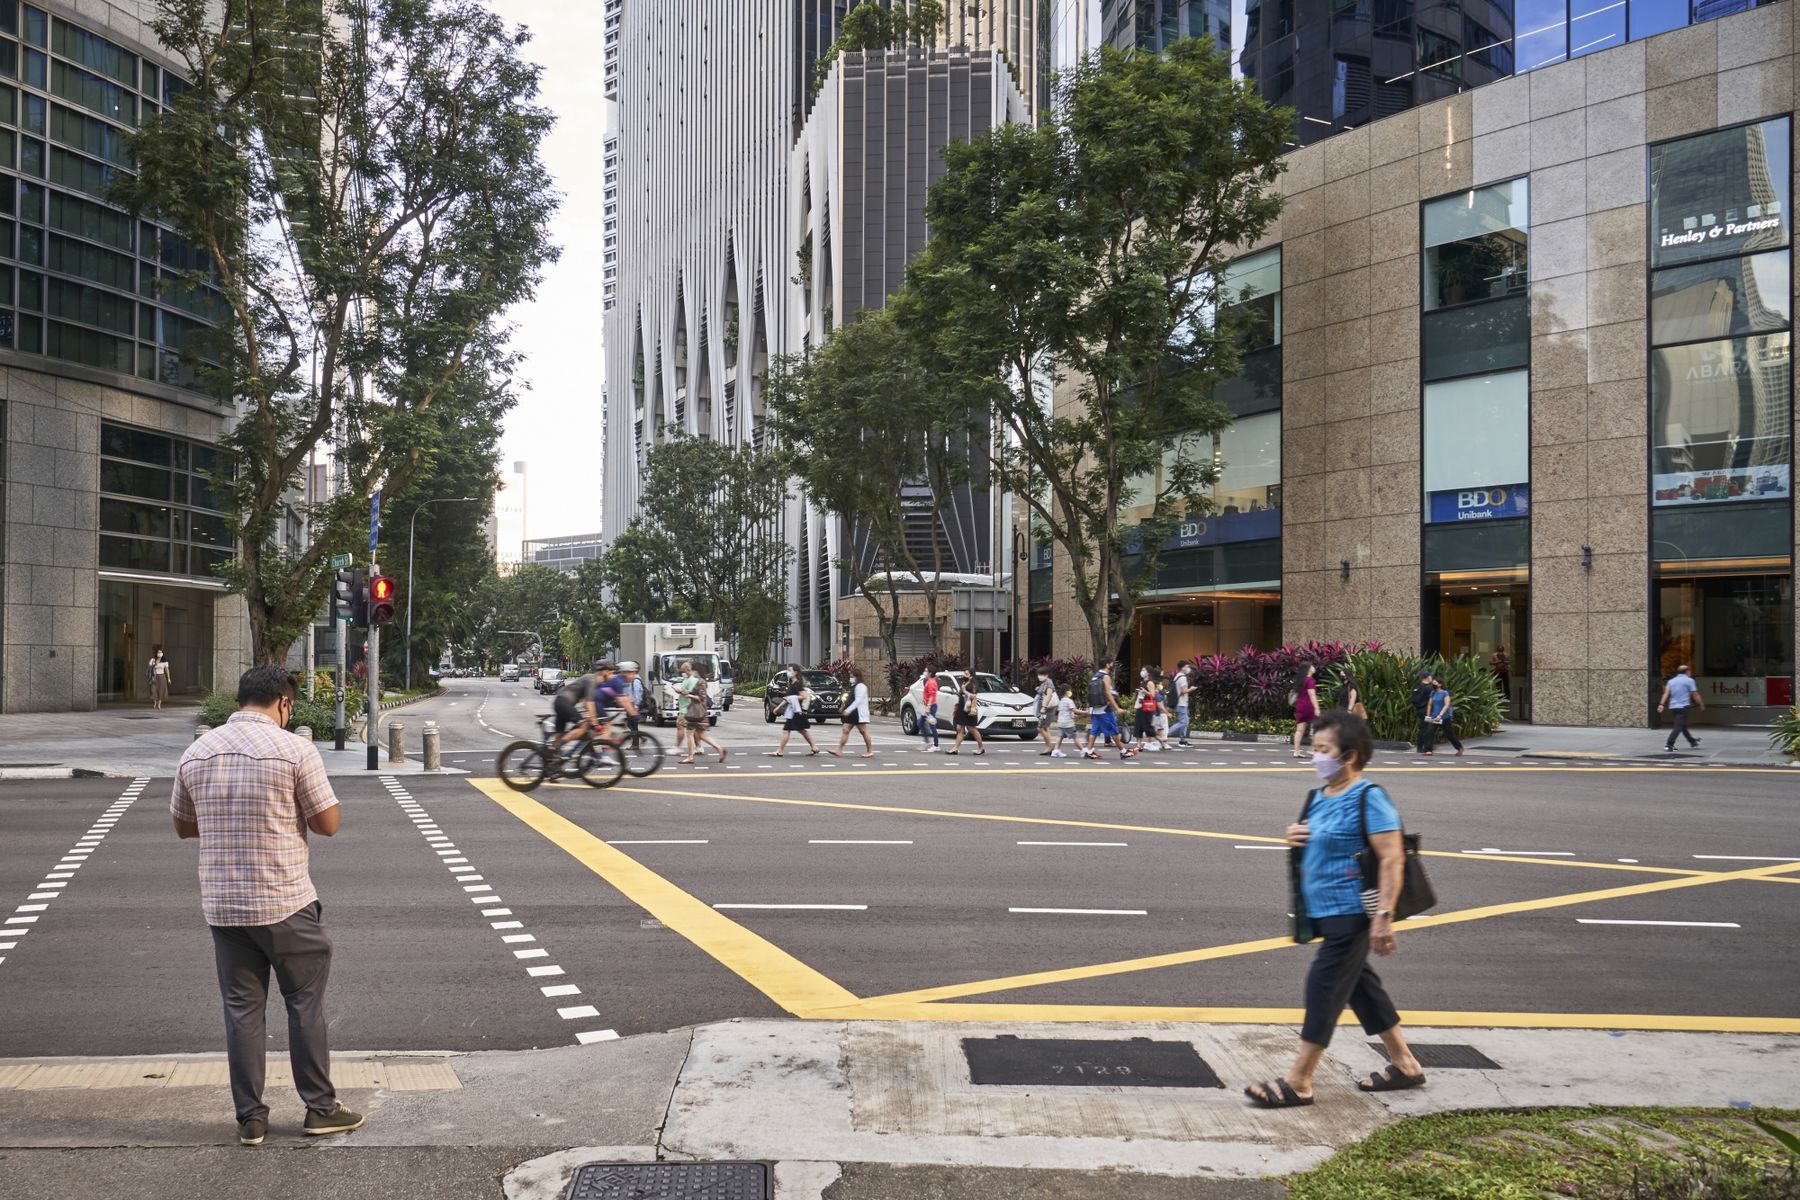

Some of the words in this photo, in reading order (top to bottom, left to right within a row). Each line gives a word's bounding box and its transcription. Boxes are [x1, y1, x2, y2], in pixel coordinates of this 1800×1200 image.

[1661, 230, 1706, 247] Henley
[1709, 226, 1723, 238] &
[1725, 218, 1780, 235] Partners
[1458, 487, 1507, 509] BDO
[1458, 509, 1492, 519] Unibank
[1180, 521, 1207, 538] BDO
